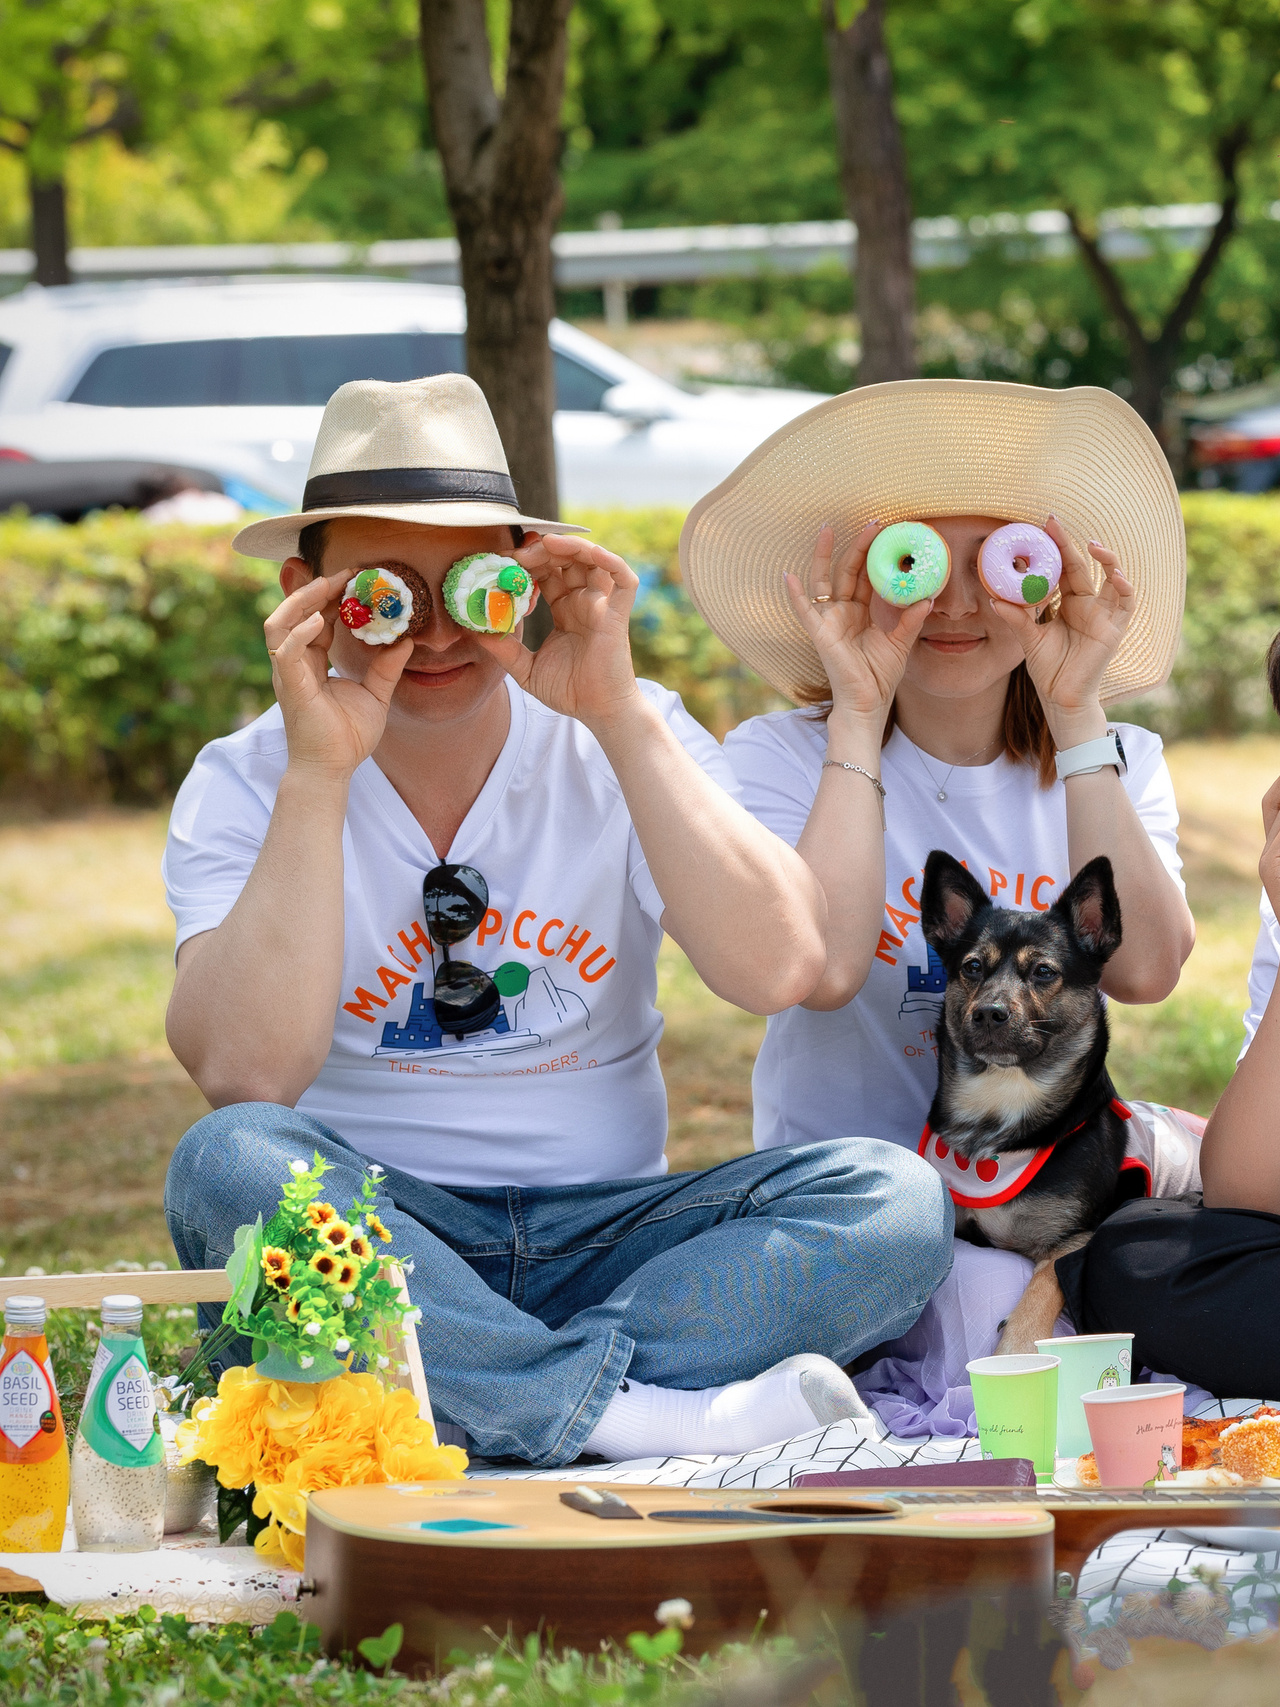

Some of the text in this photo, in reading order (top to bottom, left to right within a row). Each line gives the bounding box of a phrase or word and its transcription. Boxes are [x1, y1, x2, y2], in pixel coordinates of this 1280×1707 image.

[342, 920, 440, 1024] MACH
[388, 1060, 422, 1074] THE
[3, 1376, 42, 1390] BASIL
[116, 1379, 151, 1395] BASIL
[2, 1392, 38, 1406] SEED
[117, 1395, 150, 1411] SEED
[999, 1424, 1024, 1436] friends
[1135, 1423, 1153, 1435] Hello
